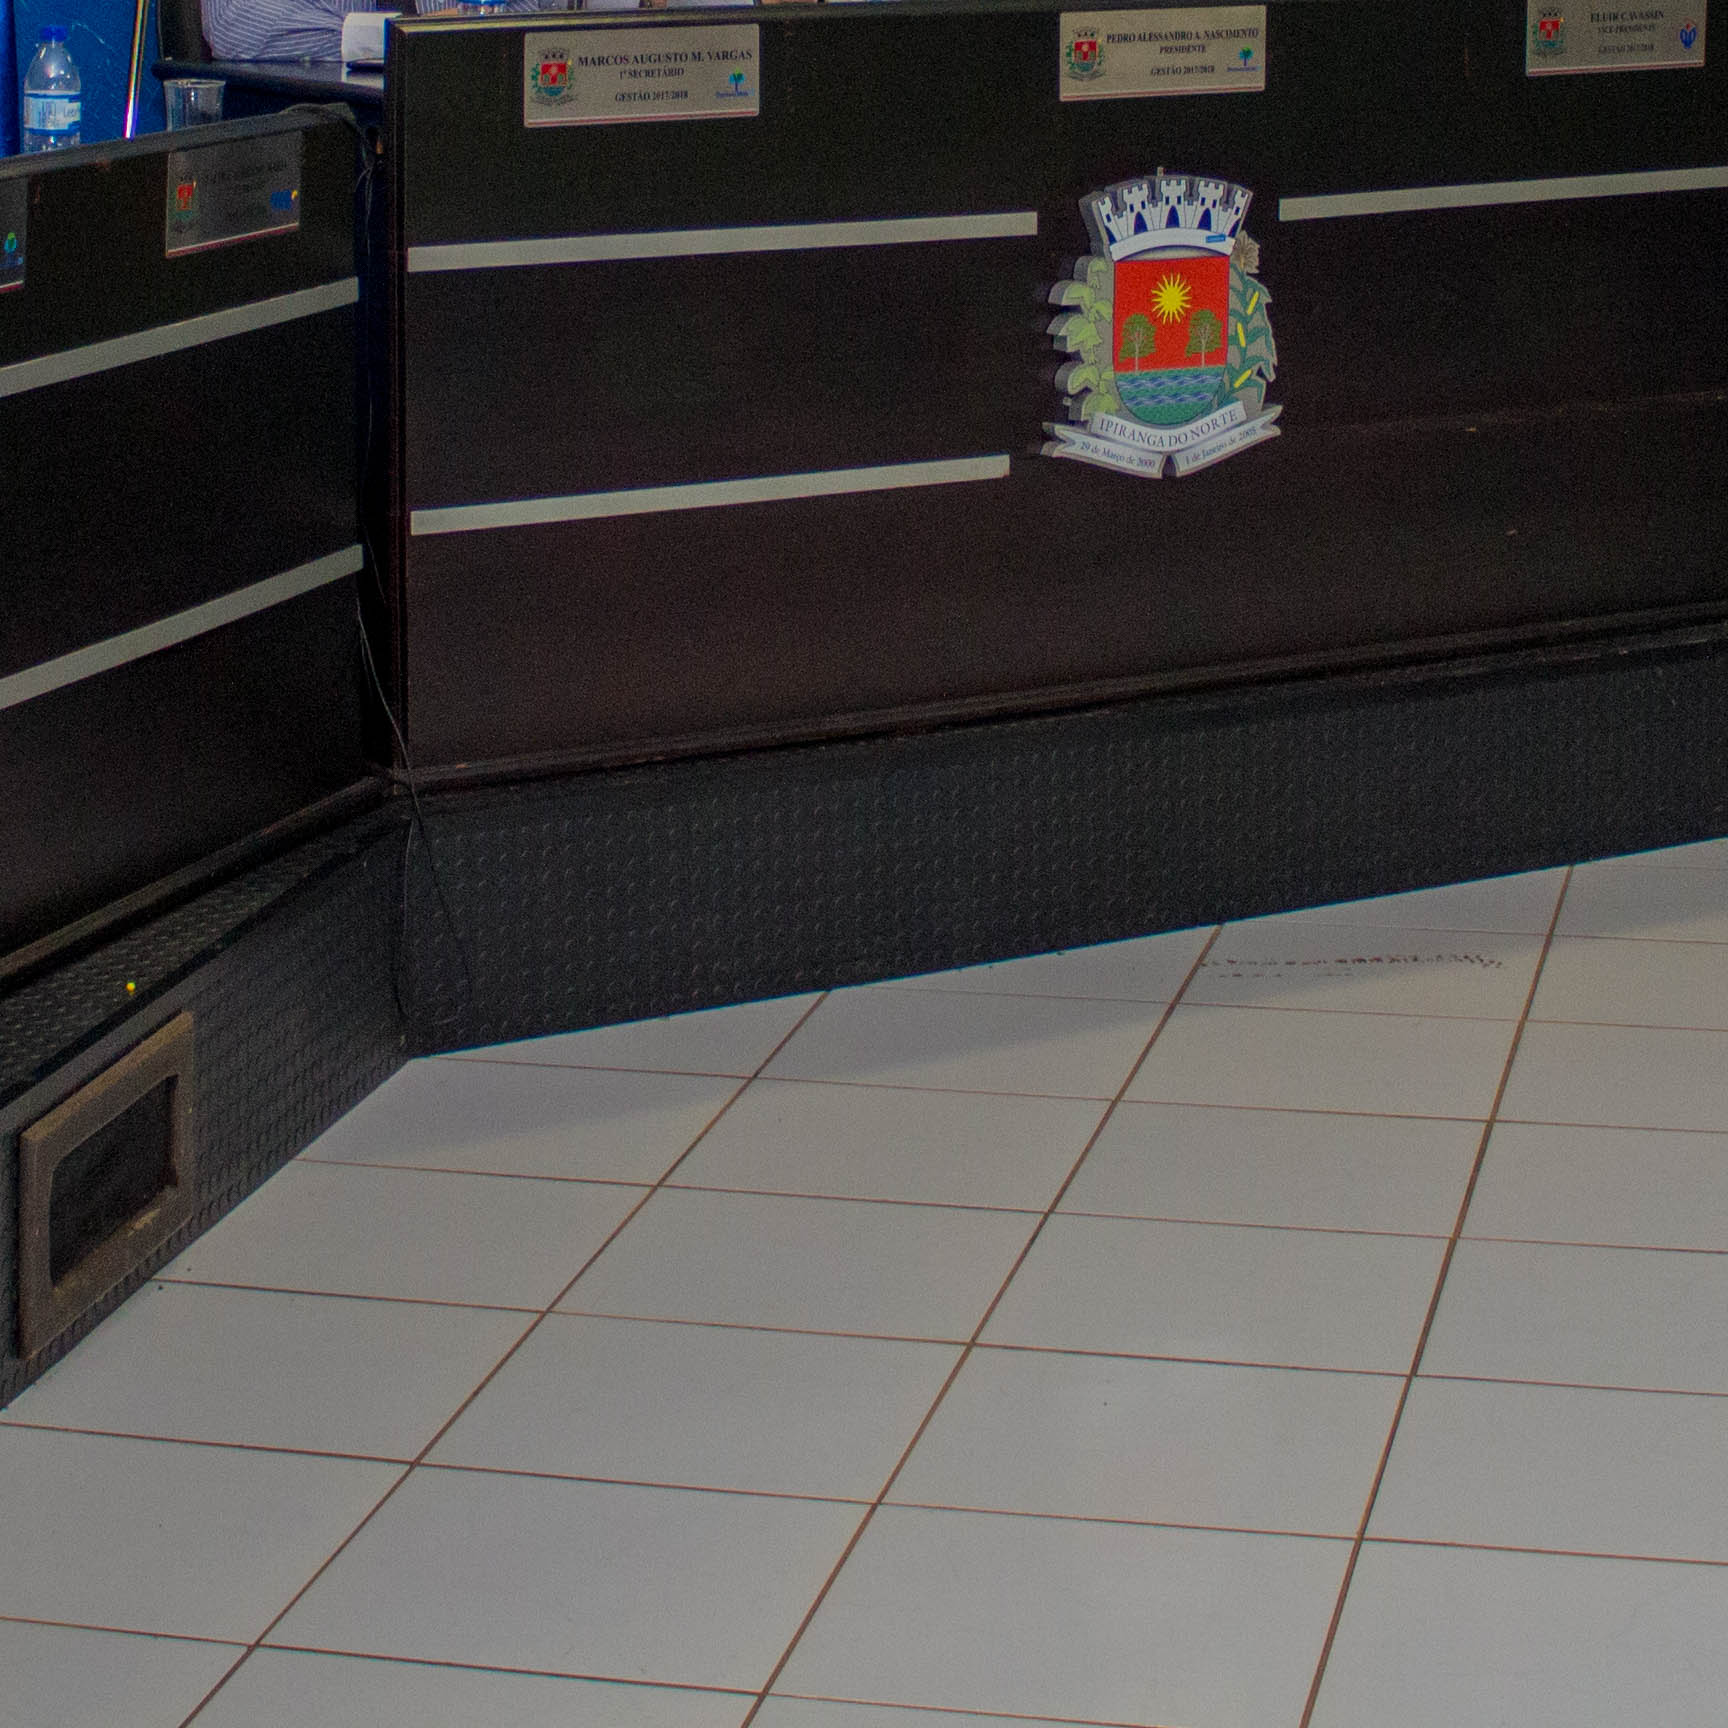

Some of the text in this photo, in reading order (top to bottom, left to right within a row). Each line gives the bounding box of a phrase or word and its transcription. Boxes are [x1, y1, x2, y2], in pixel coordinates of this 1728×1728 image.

[578, 55, 630, 67] MARCOS
[633, 52, 689, 64] AUGUSTO
[707, 49, 753, 61] VARGAS
[1100, 409, 1239, 448] IPIRANGA DO NORTE
